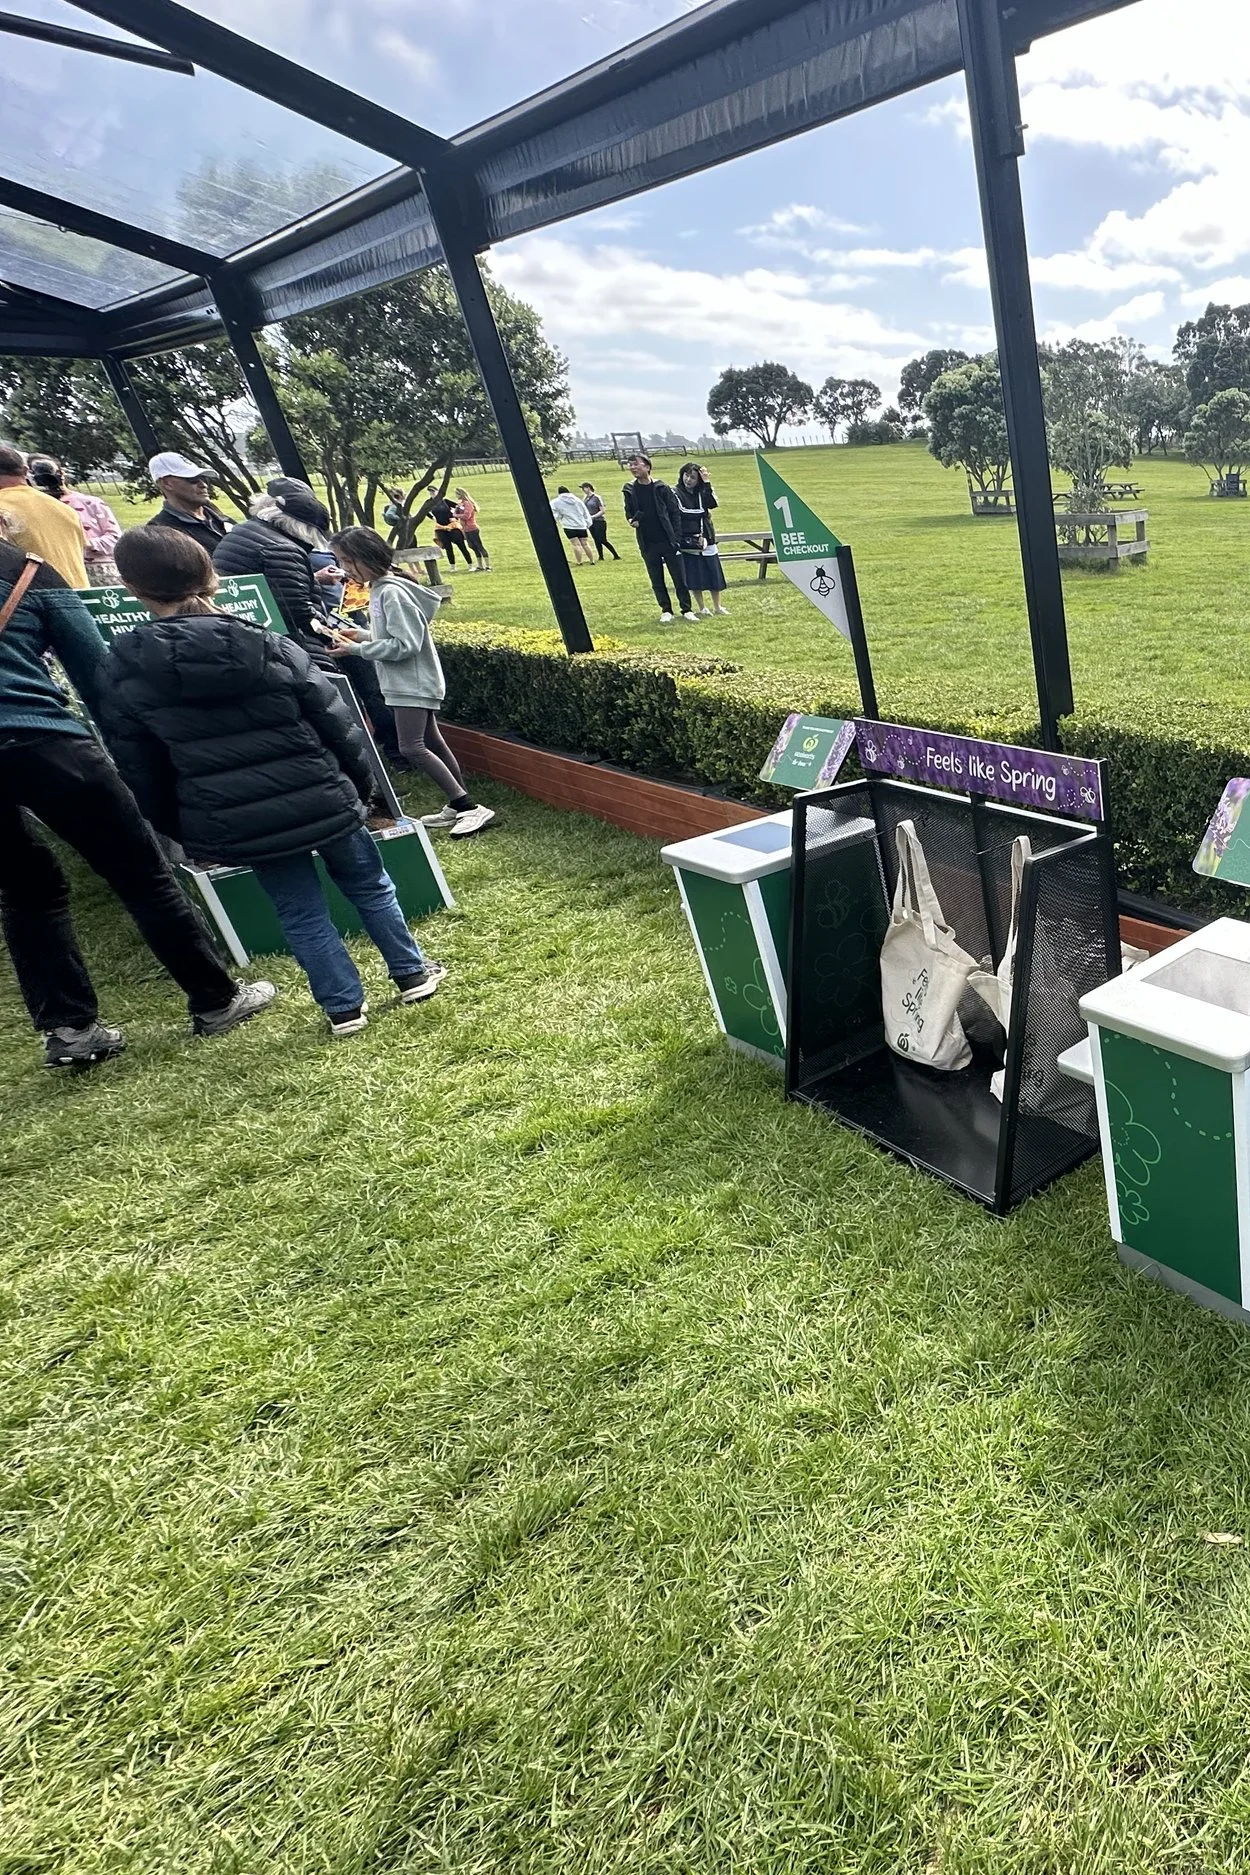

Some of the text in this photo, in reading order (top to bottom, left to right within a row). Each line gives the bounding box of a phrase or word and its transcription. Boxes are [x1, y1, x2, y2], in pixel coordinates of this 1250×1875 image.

[773, 495, 794, 529] 1
[781, 532, 807, 545] BEE
[783, 543, 829, 555] CHECKOUT
[110, 624, 136, 636] HIV
[926, 747, 1056, 801] Feels like Spring
